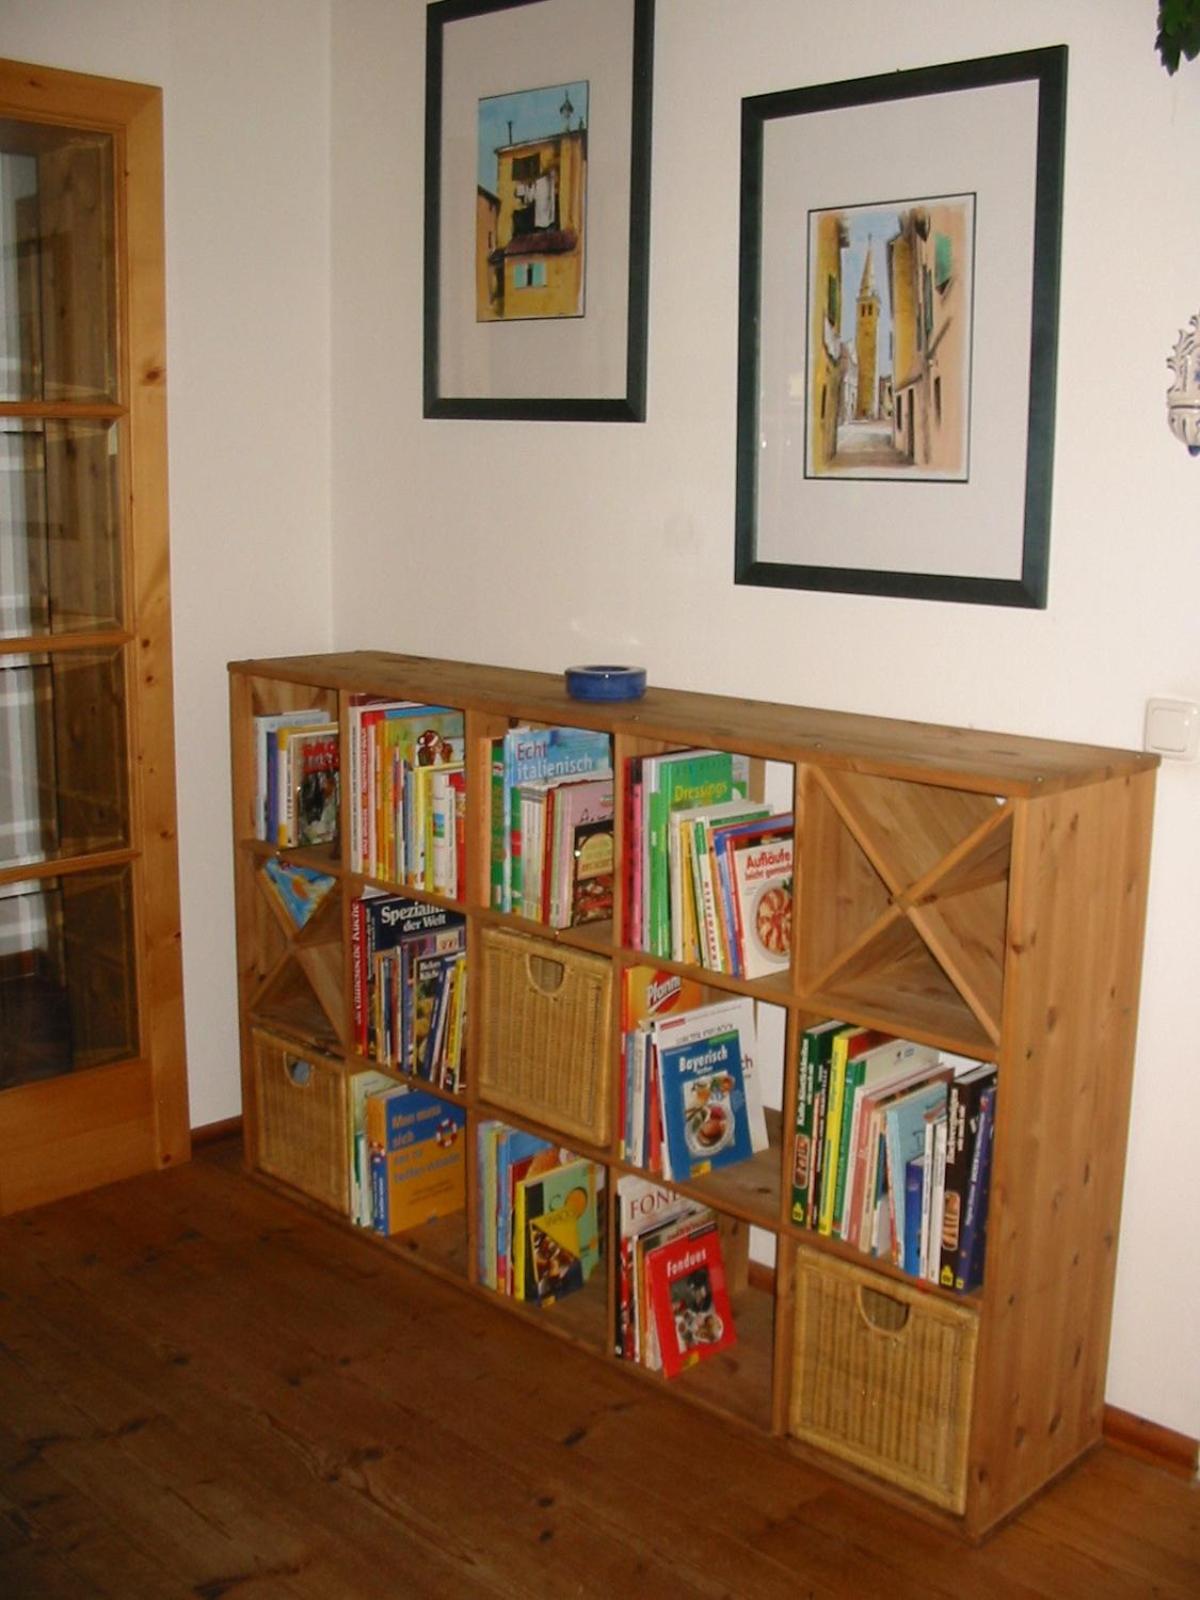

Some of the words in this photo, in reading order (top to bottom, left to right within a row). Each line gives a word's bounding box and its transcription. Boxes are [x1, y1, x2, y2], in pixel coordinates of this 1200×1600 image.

[516, 754, 593, 781] italienisch
[403, 919, 422, 932] der
[422, 913, 447, 928] Welt
[678, 1044, 729, 1073] Bayerisch
